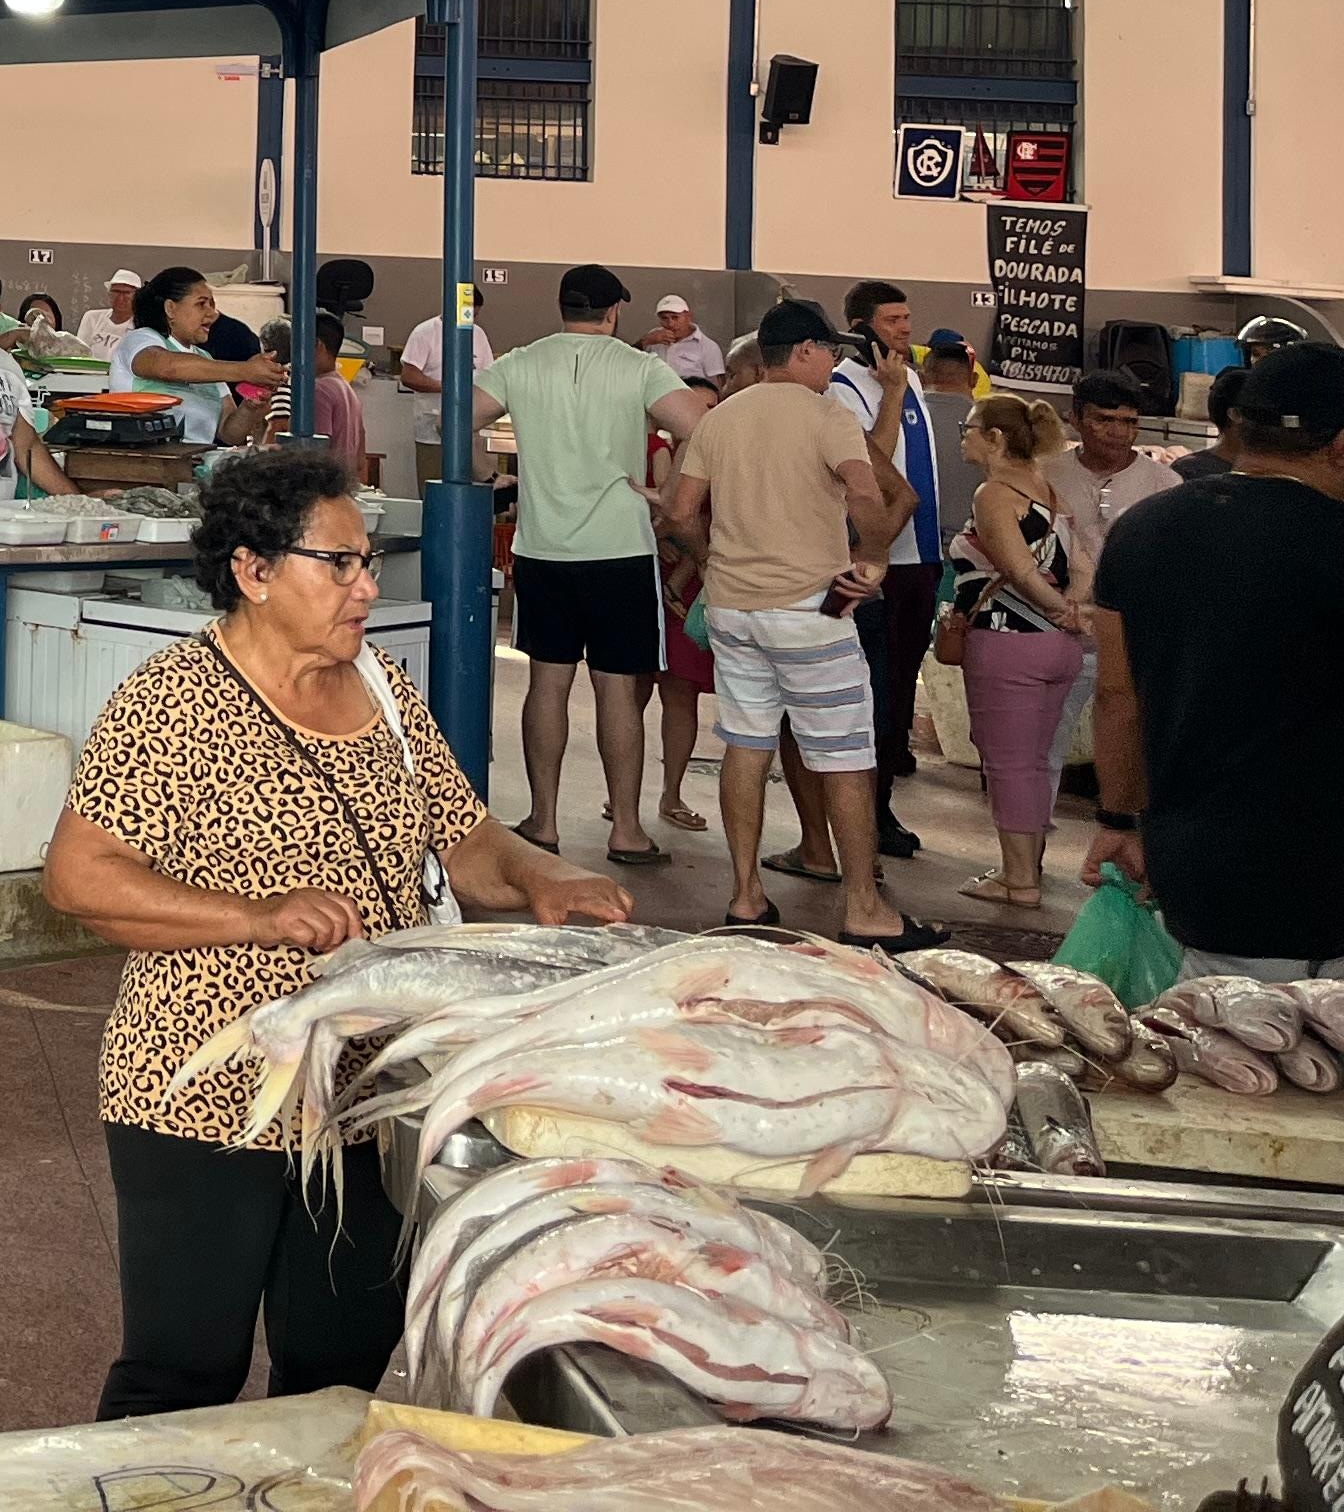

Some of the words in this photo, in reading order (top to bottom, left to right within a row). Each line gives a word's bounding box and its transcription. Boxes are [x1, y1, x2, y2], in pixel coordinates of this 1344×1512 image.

[1001, 216, 1066, 236] TEMOS
[1059, 243, 1075, 253] DE
[32, 250, 51, 262] 17
[485, 269, 506, 282] 15
[994, 259, 1083, 284] DOURADA
[974, 293, 995, 305] 13
[1000, 313, 1078, 339] PESCADA
[1011, 347, 1038, 362] PIX
